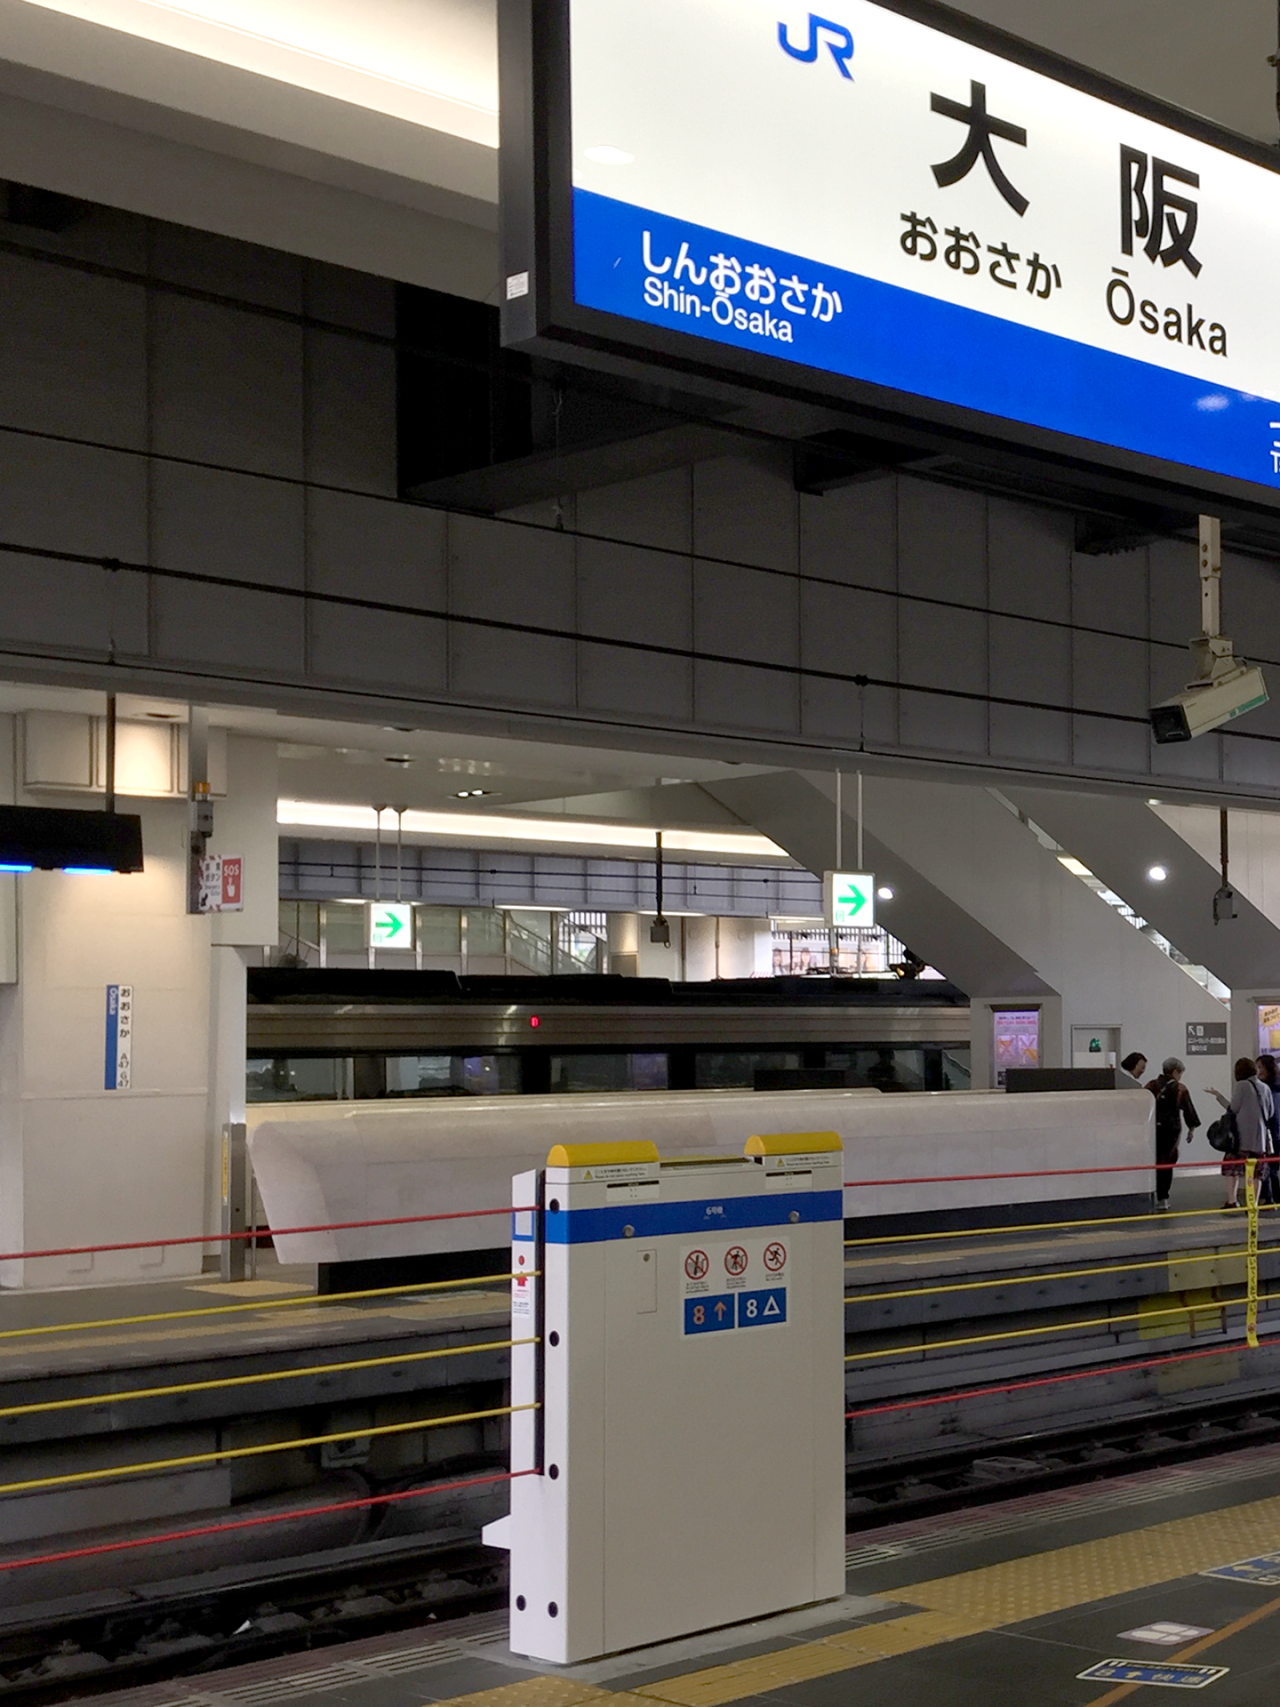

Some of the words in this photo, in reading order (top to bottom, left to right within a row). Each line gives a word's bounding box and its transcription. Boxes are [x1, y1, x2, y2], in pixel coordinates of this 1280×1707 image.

[777, 12, 855, 82] JR
[930, 79, 1203, 280] 大阪
[642, 230, 842, 323] しんおおさか
[900, 211, 1062, 300] おおさか
[643, 277, 794, 343] Shin-Ōsaka
[1105, 266, 1228, 357] Ōsaka
[224, 864, 239, 876] SOS
[120, 988, 130, 1038] おおさか
[693, 1305, 705, 1325] 8
[746, 1299, 758, 1318] 8
